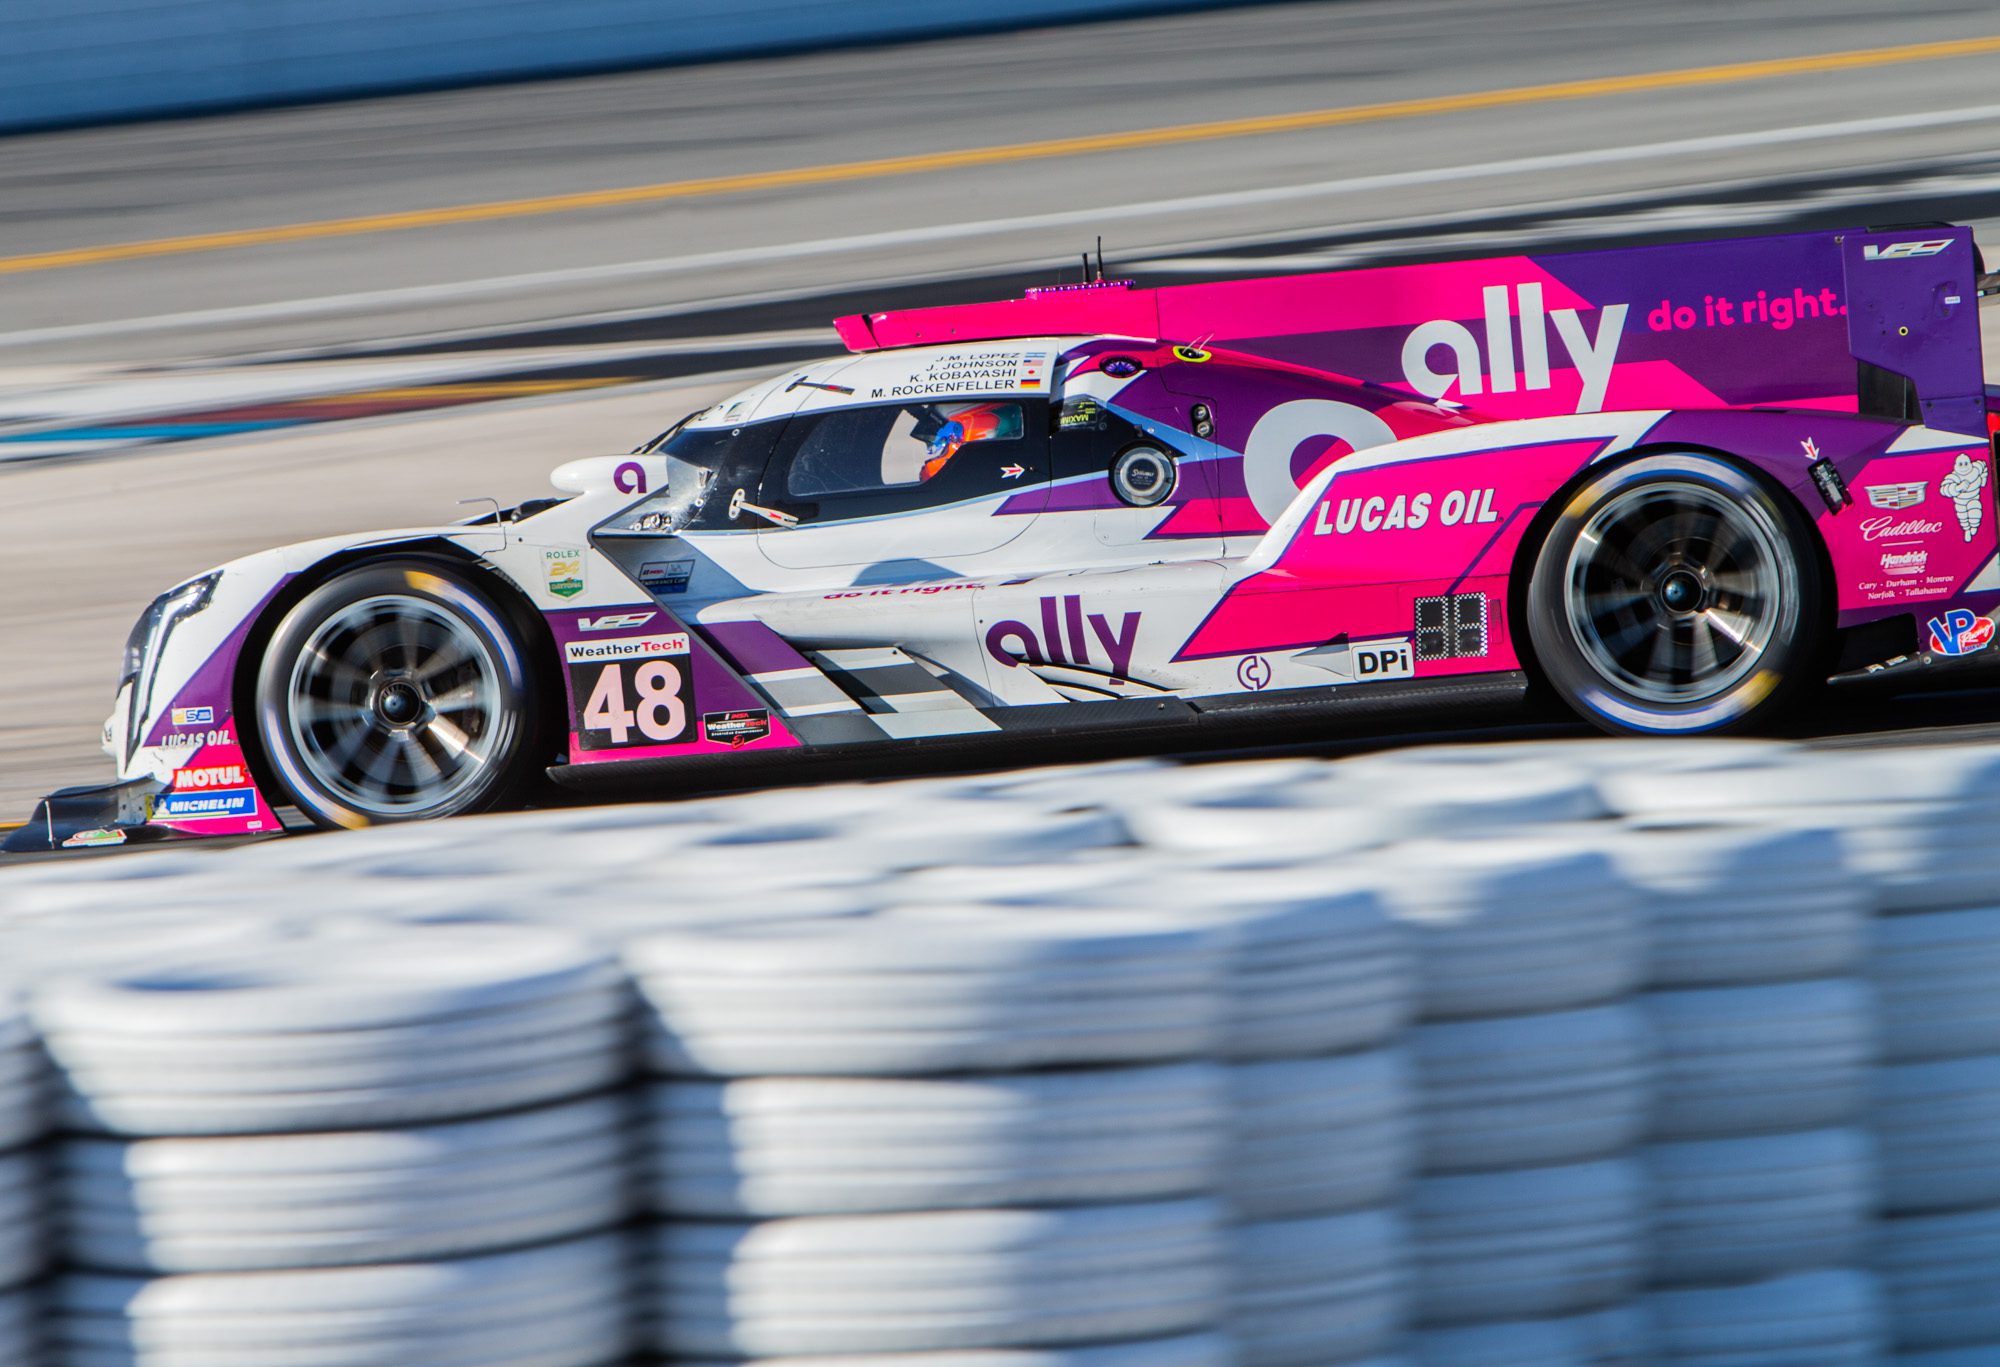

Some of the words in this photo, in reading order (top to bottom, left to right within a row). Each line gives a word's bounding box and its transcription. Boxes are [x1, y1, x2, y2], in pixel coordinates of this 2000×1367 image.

[1648, 299, 1697, 332] do
[1704, 295, 1735, 327] it
[1742, 287, 1848, 330] right.
[935, 353, 963, 362] J.M.
[969, 352, 1021, 361] LOPEZ
[1401, 282, 1629, 414] ally
[909, 374, 923, 383] K.
[928, 368, 1017, 382] KOBAYASHI
[926, 363, 938, 372] J.
[944, 360, 1018, 370] JOHNSON
[871, 388, 887, 398] M.
[892, 379, 1015, 396] ROCKENFELLER
[613, 461, 647, 494] a
[1313, 492, 1433, 536] LUCAS
[1439, 488, 1499, 527] OIL
[1859, 515, 1944, 542] Cadillac
[546, 550, 580, 560] ROLEX
[1880, 550, 1928, 569] Hendrick
[1858, 581, 1878, 591] Cary
[1886, 578, 1918, 588] Durham
[1926, 575, 1955, 584] Monroe
[823, 592, 862, 600] do
[1867, 590, 1896, 601] Norfolk
[1904, 586, 1948, 597] Tallahassee
[985, 594, 1142, 686] ally
[1927, 609, 1976, 654] VP
[570, 638, 684, 658] WeatherTech
[1358, 649, 1409, 675] DPi
[583, 660, 686, 744] 48
[707, 719, 767, 731] WeatherTech
[160, 732, 205, 750] LUCAS
[206, 730, 232, 747] OIL
[176, 765, 245, 788] MOTUL
[170, 796, 245, 812] MICHELIN
